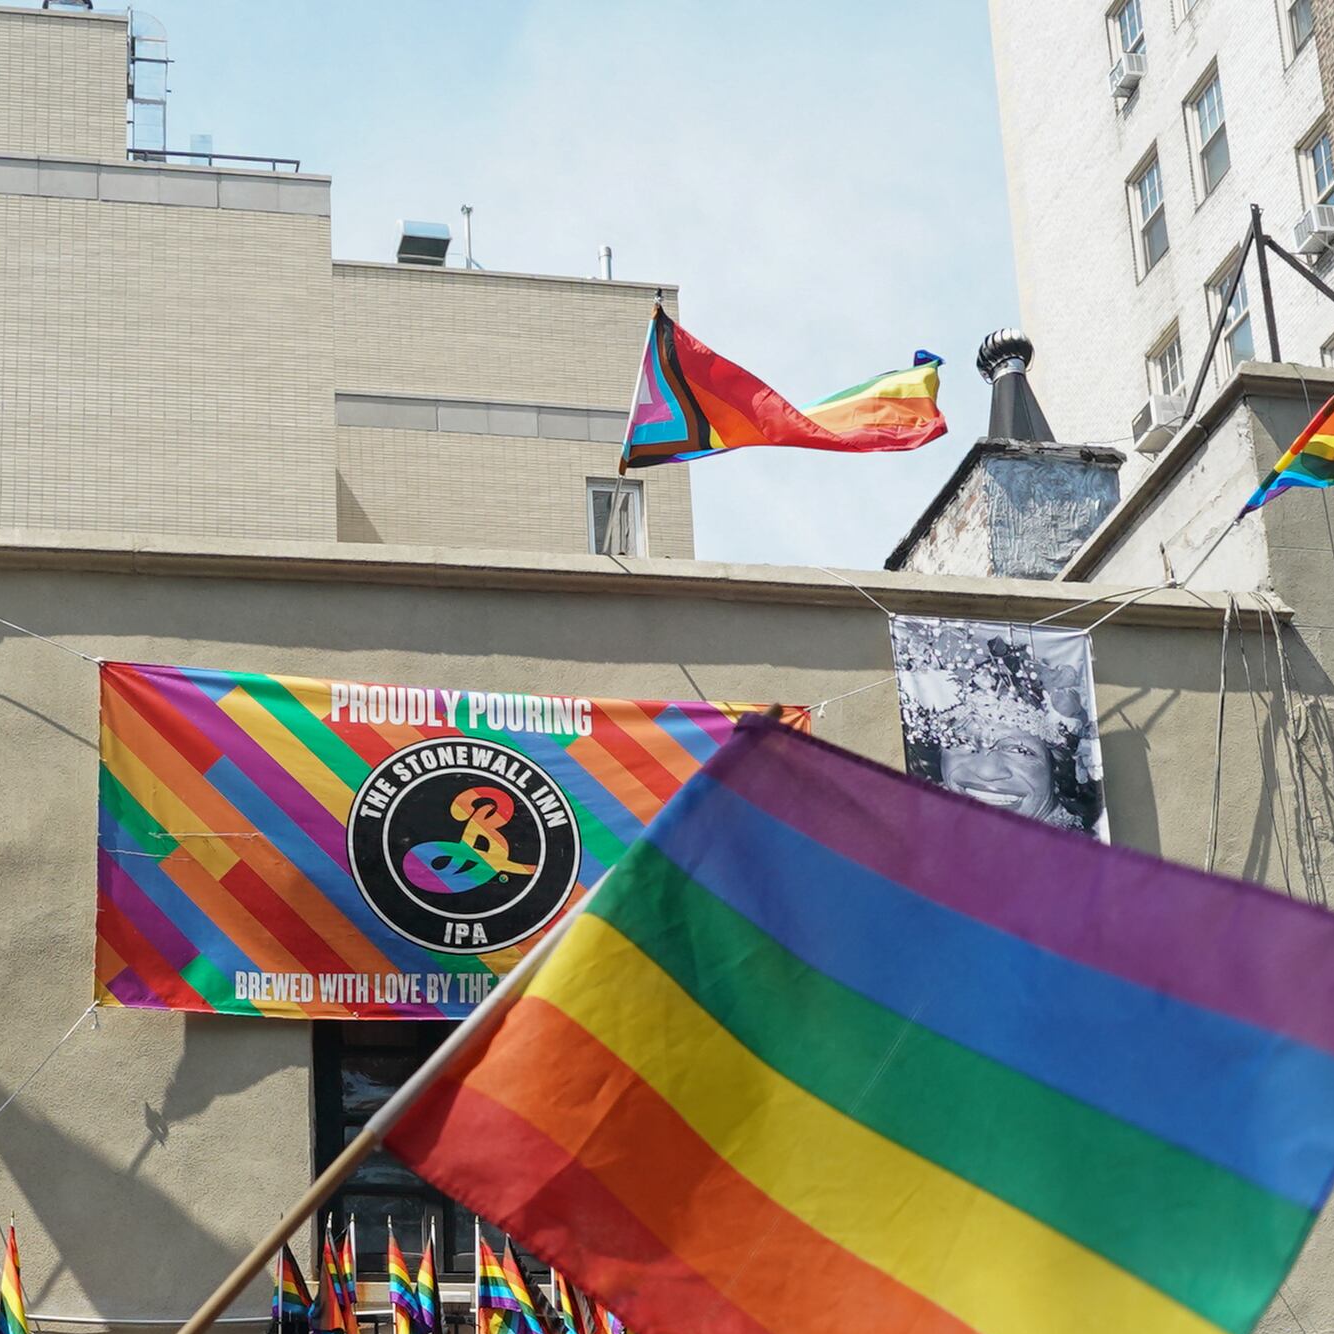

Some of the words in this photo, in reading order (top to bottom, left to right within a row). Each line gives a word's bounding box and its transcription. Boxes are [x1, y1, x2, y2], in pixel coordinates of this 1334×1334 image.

[330, 683, 461, 728] PROUDLY
[468, 691, 593, 737] POURING
[360, 777, 397, 820] THE
[392, 745, 533, 790] STONEWALL
[530, 785, 568, 829] INN
[443, 922, 488, 945] IPA
[235, 970, 312, 1001] BREWED
[318, 973, 367, 1004] WITH
[373, 973, 421, 1004] LOVE
[426, 973, 452, 1004] BY
[457, 973, 493, 1004] THE
